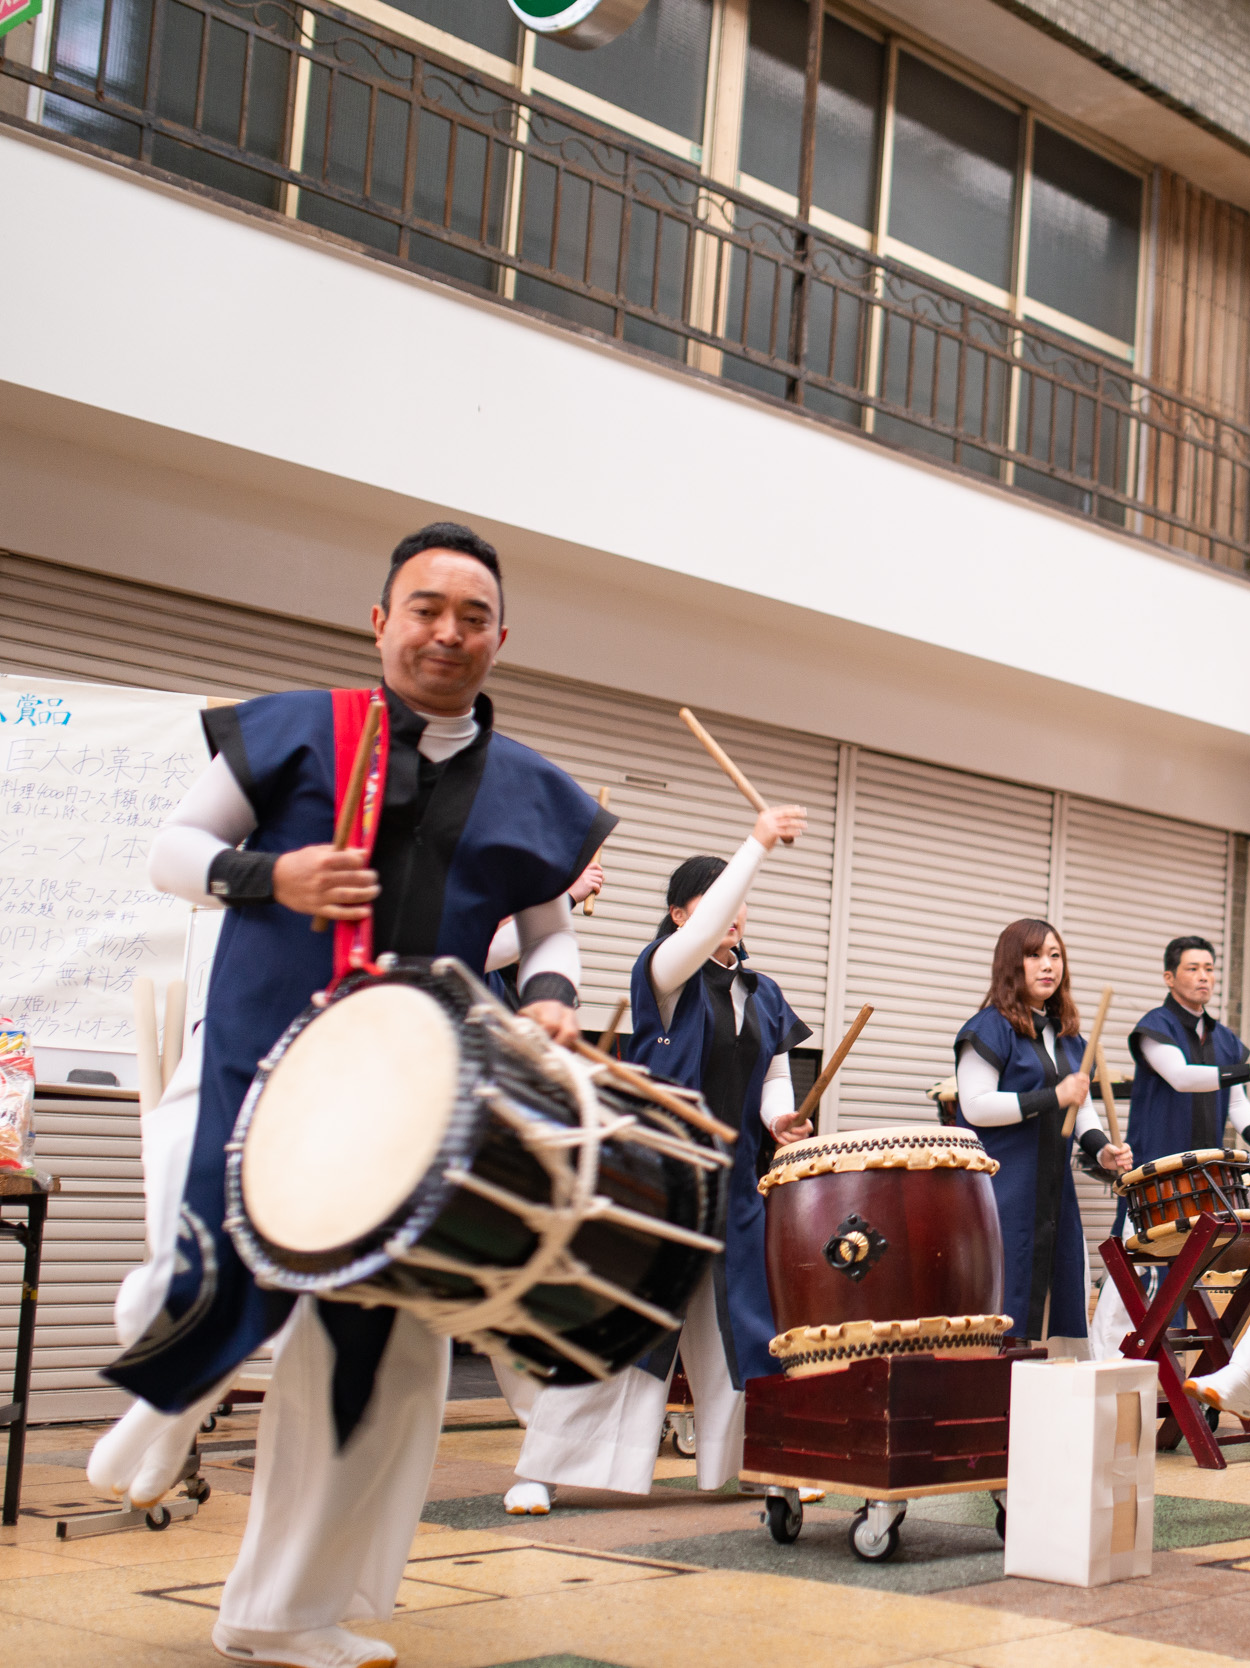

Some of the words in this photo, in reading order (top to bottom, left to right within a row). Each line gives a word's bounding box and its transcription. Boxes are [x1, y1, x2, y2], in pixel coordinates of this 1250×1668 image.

[0, 693, 72, 727] 賞品
[6, 738, 196, 790] 巨大お菓子袋
[0, 956, 139, 992] ンチ無料券
